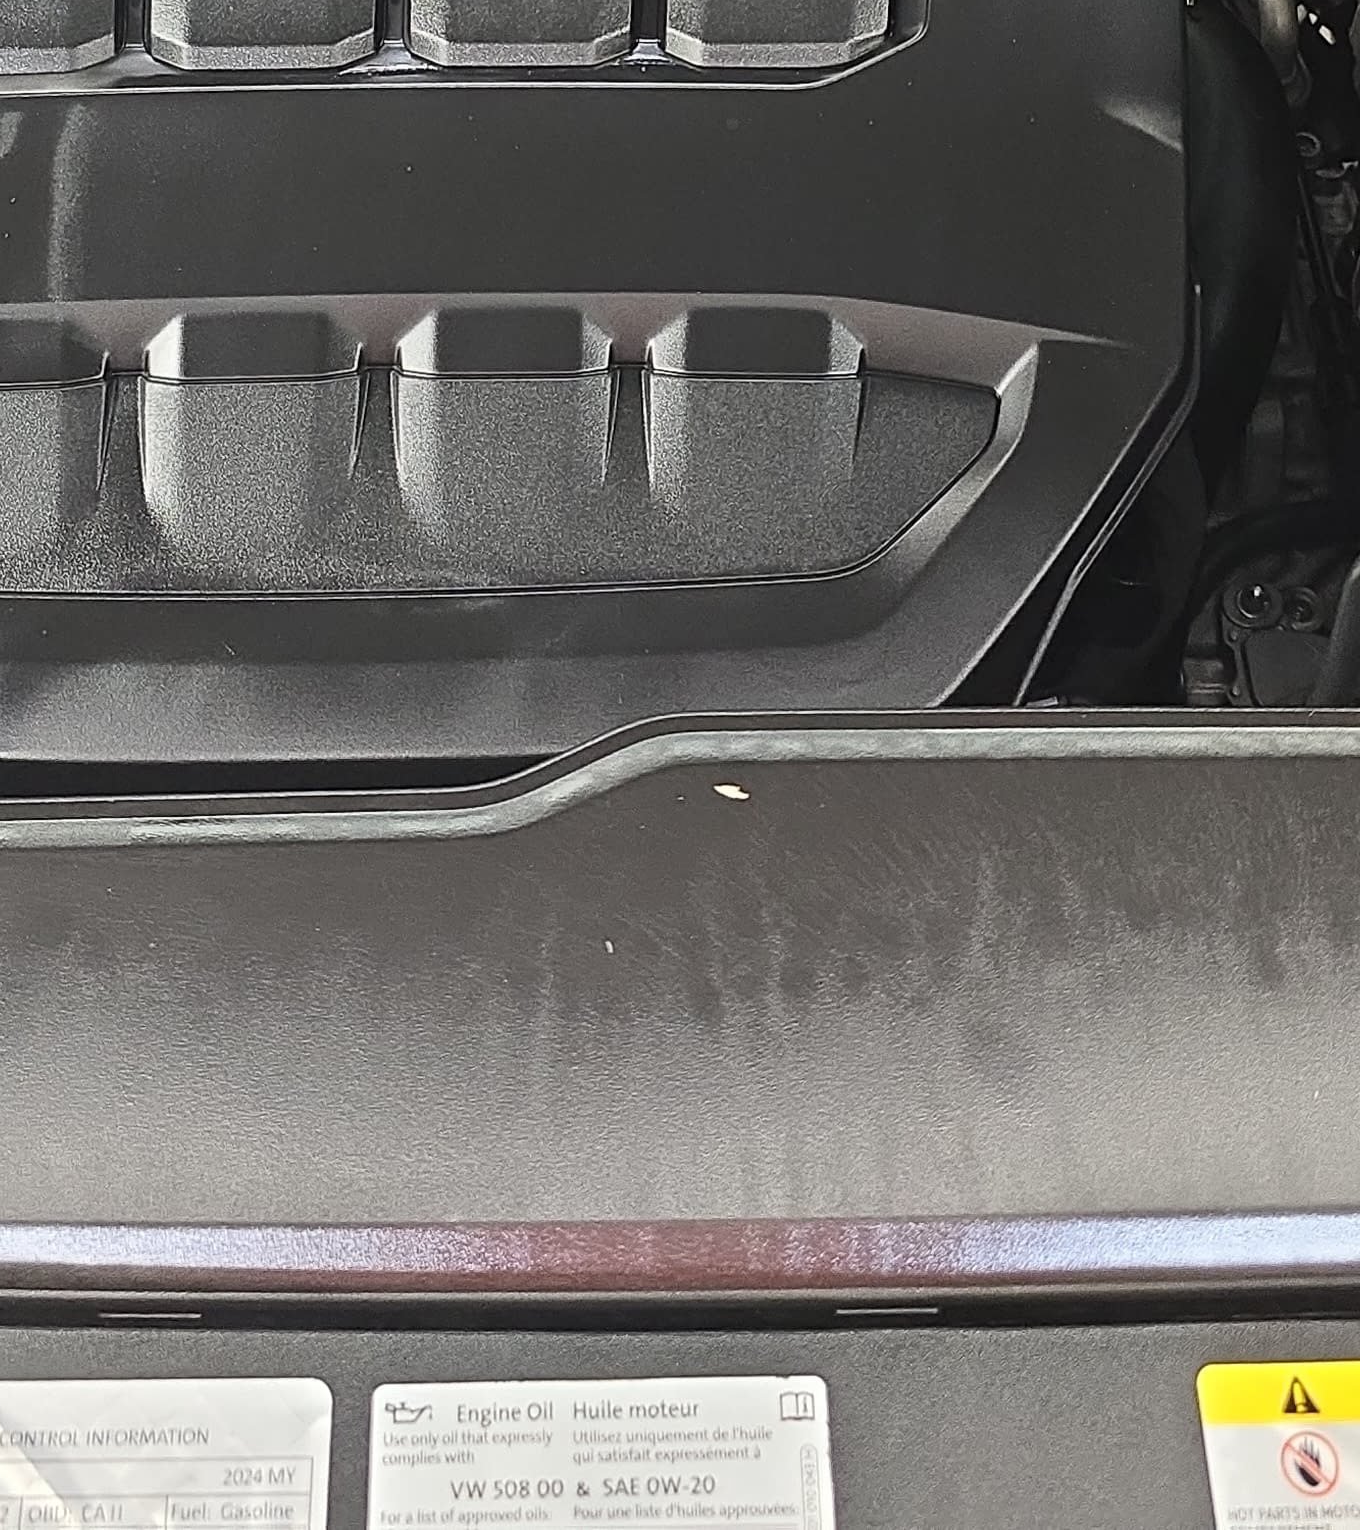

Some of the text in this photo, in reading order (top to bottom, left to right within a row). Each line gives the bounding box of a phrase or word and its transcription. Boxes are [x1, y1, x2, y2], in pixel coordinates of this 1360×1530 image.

[456, 1400, 554, 1429] Engine Oil
[572, 1399, 700, 1421] Huile moteur
[86, 1427, 210, 1447] INFORMATION
[383, 1428, 554, 1450] Use only oil that expressly
[572, 1425, 774, 1446] Utilisez uniquement de l'huile
[381, 1449, 476, 1468] complies with
[572, 1448, 595, 1467] qui
[596, 1447, 651, 1464] satisfait
[654, 1445, 750, 1465] expressément
[222, 1467, 297, 1487] 2024 MY
[449, 1474, 717, 1500] VW 508 00 & SAE 0W-20
[220, 1500, 296, 1521] Gasoline
[380, 1510, 403, 1525] For
[416, 1508, 437, 1524] list
[440, 1506, 456, 1523] of
[457, 1506, 523, 1526] approved
[573, 1503, 603, 1521] Pour
[606, 1505, 632, 1520] une
[634, 1503, 661, 1519] liste
[1257, 1504, 1301, 1520] PARTS
